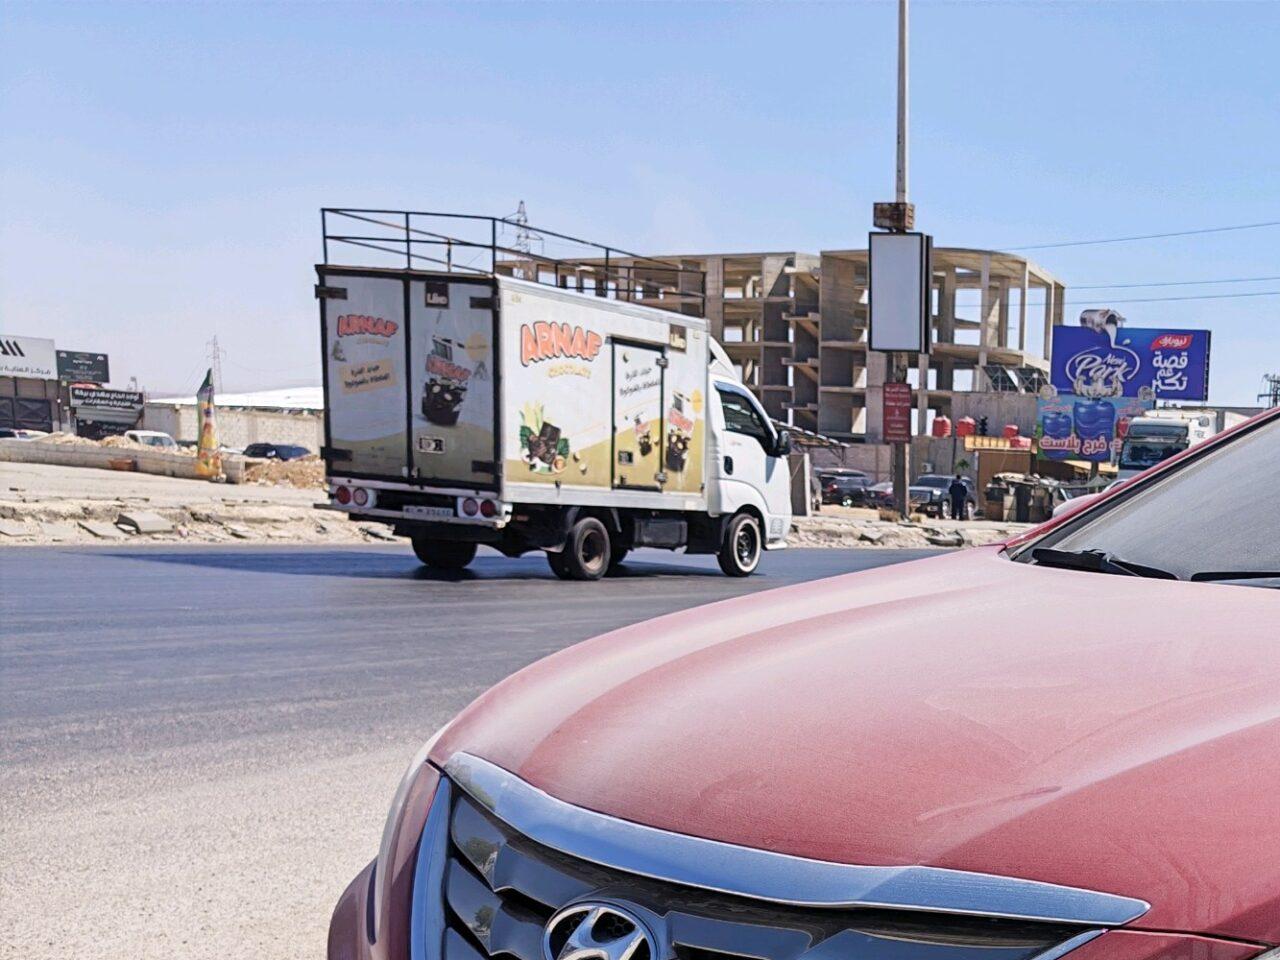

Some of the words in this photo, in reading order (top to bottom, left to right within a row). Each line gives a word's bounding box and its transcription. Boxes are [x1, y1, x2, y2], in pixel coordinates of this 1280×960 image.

[521, 320, 603, 367] ARNAF
[1074, 354, 1133, 383] Park
[1152, 350, 1188, 369] قصة
